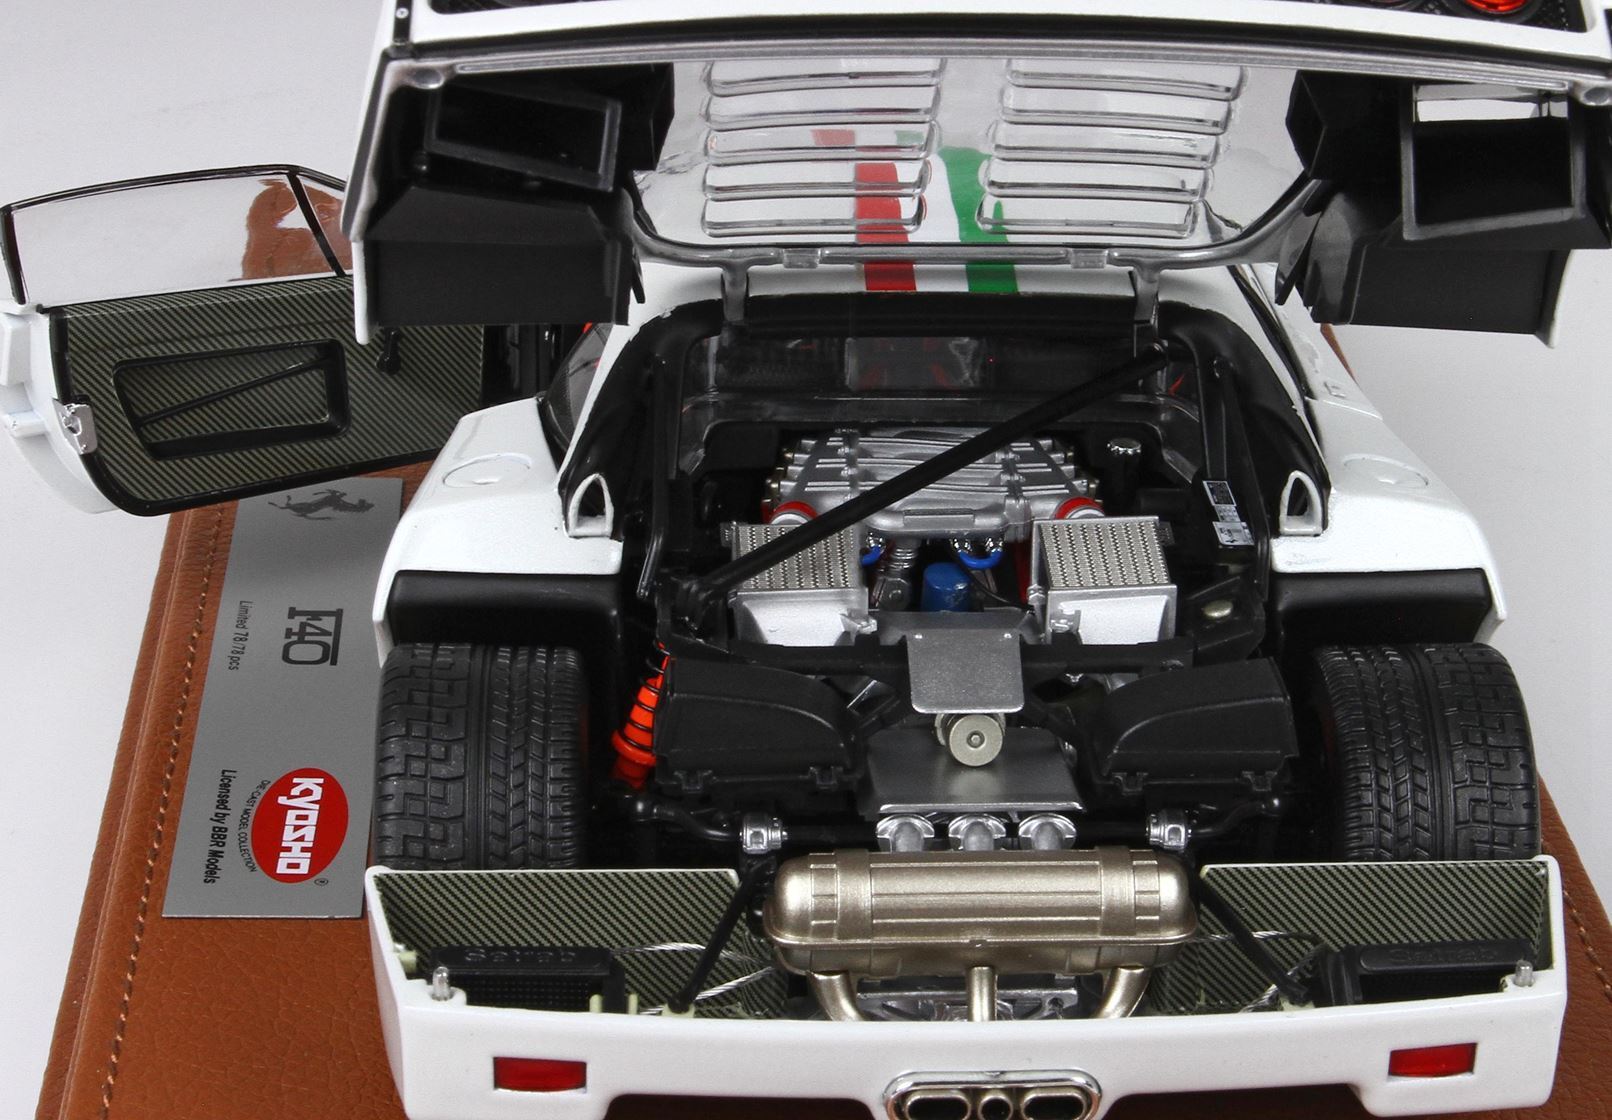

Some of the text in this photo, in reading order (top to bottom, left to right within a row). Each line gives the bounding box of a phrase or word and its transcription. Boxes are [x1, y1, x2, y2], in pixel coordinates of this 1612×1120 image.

[227, 600, 254, 671] Limited 78/78 pcs
[203, 769, 237, 884] Licensed by BBR Models
[238, 779, 271, 873] DIE-CAST MODEL COLLECTION
